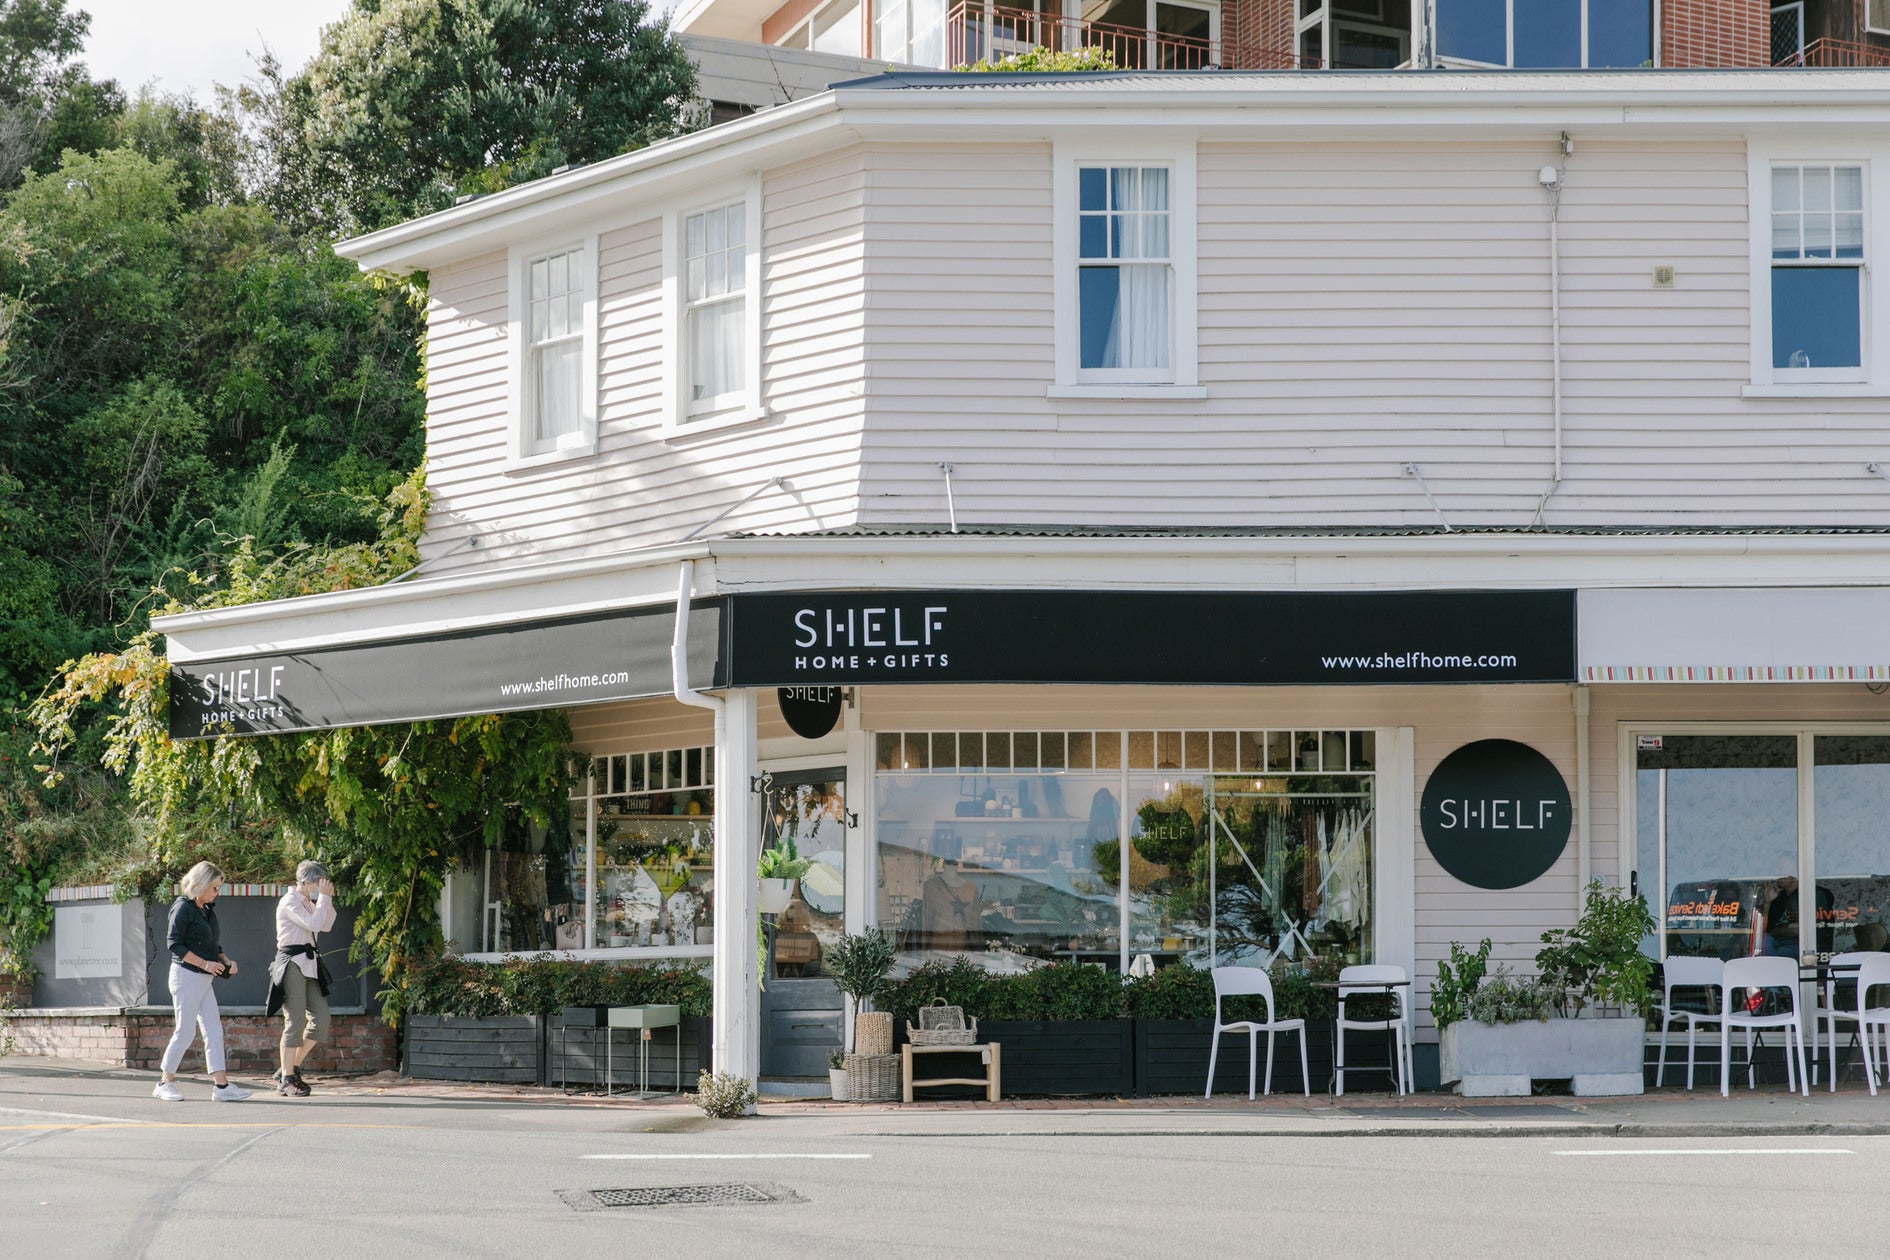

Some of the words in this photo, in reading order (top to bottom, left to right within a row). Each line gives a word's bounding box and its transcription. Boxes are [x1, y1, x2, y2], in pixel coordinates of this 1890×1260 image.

[794, 606, 948, 648] SHELF
[1321, 652, 1517, 668] www.shelfhome.com
[201, 665, 285, 706] SHELF
[500, 671, 629, 696] www.shelfhome.com
[626, 799, 650, 809] THING
[1440, 799, 1557, 829] SHELF
[1139, 826, 1188, 840] SHELF
